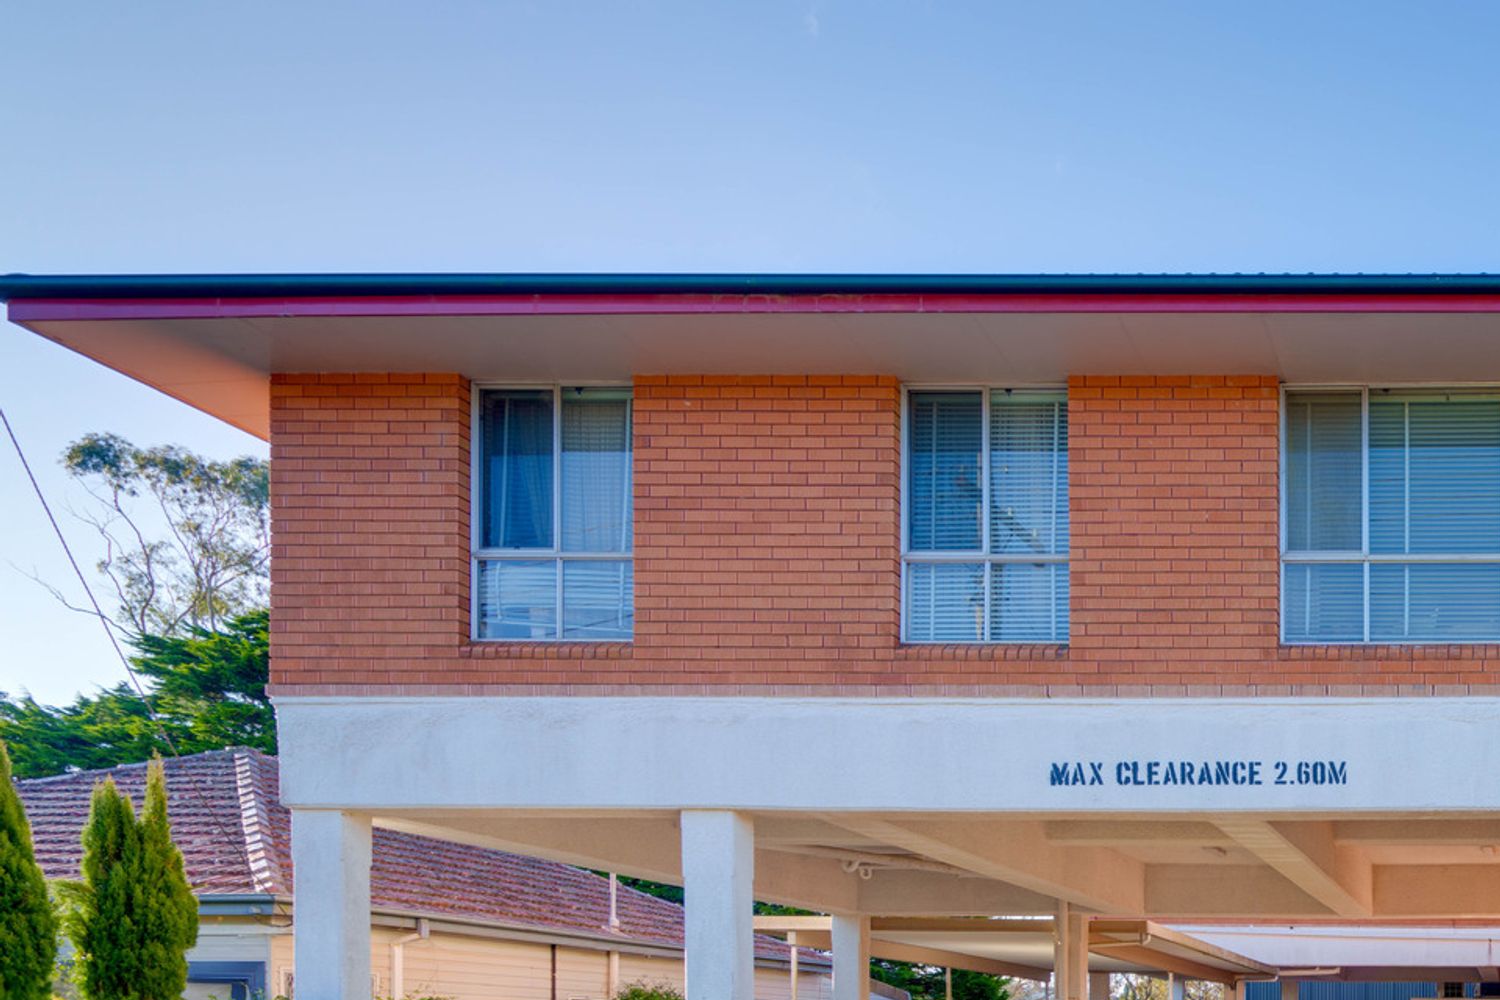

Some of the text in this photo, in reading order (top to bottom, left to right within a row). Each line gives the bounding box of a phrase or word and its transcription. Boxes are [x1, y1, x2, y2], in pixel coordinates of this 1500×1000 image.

[1050, 760, 1347, 786] MAX CLEARANCE 2.60M
